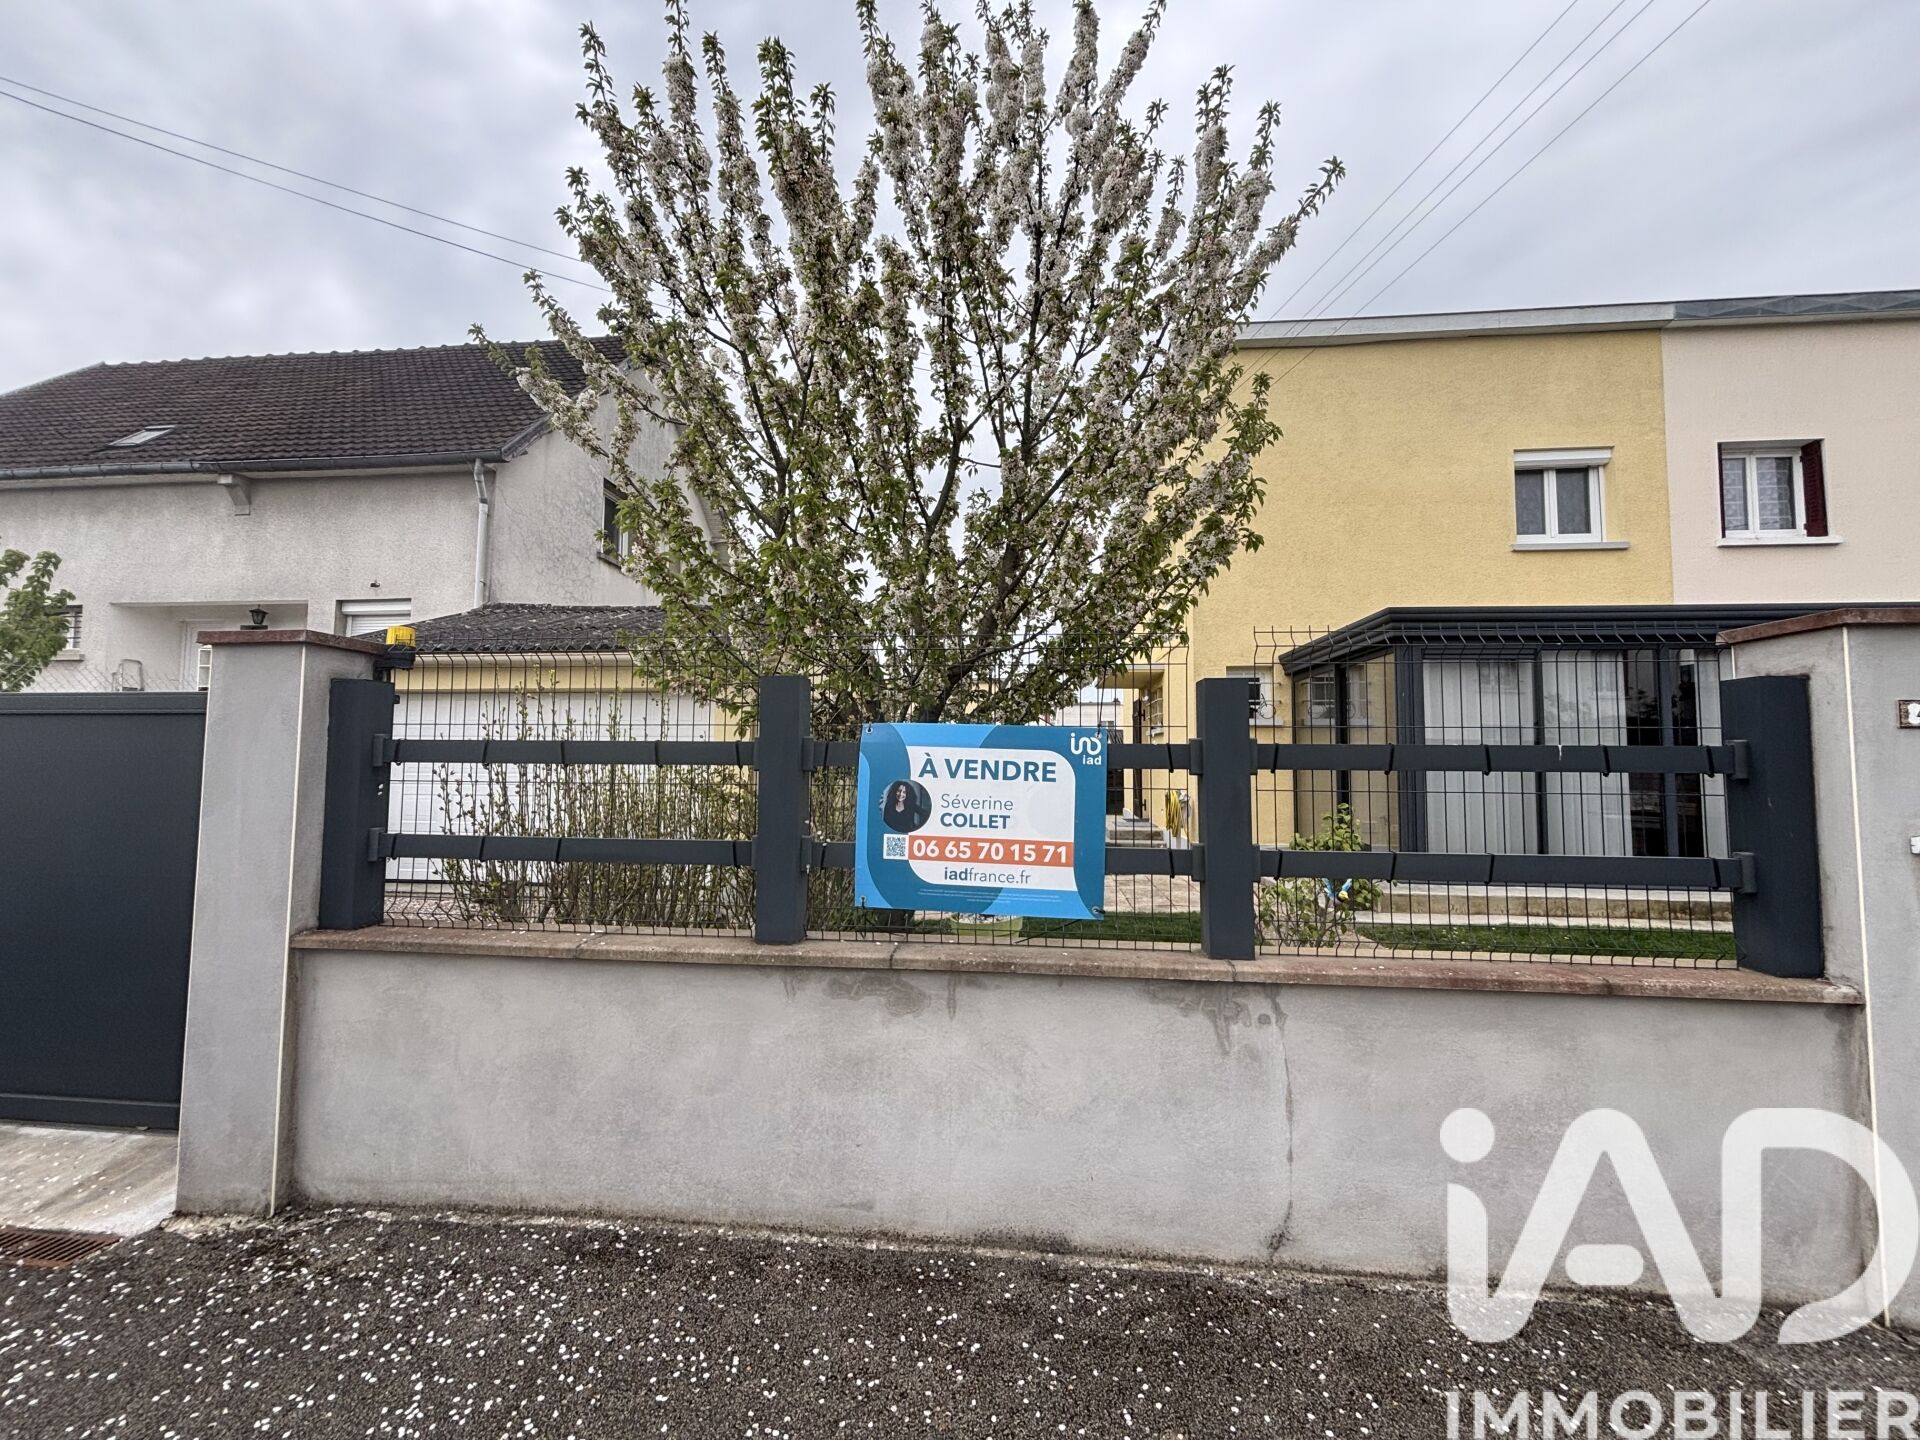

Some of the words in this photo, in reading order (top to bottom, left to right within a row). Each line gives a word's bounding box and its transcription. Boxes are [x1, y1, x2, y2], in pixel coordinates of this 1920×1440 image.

[918, 752, 938, 778] À
[944, 758, 1057, 783] VENDRE
[1082, 754, 1102, 765] iad
[940, 793, 1014, 811] Séverine
[940, 812, 1011, 830] COLLET
[912, 839, 939, 857] 06
[944, 841, 972, 859] 65
[977, 843, 1004, 860] 70
[1009, 844, 1036, 862] 15
[1041, 846, 1067, 863] 71
[943, 866, 1031, 885] iadfrance.fr
